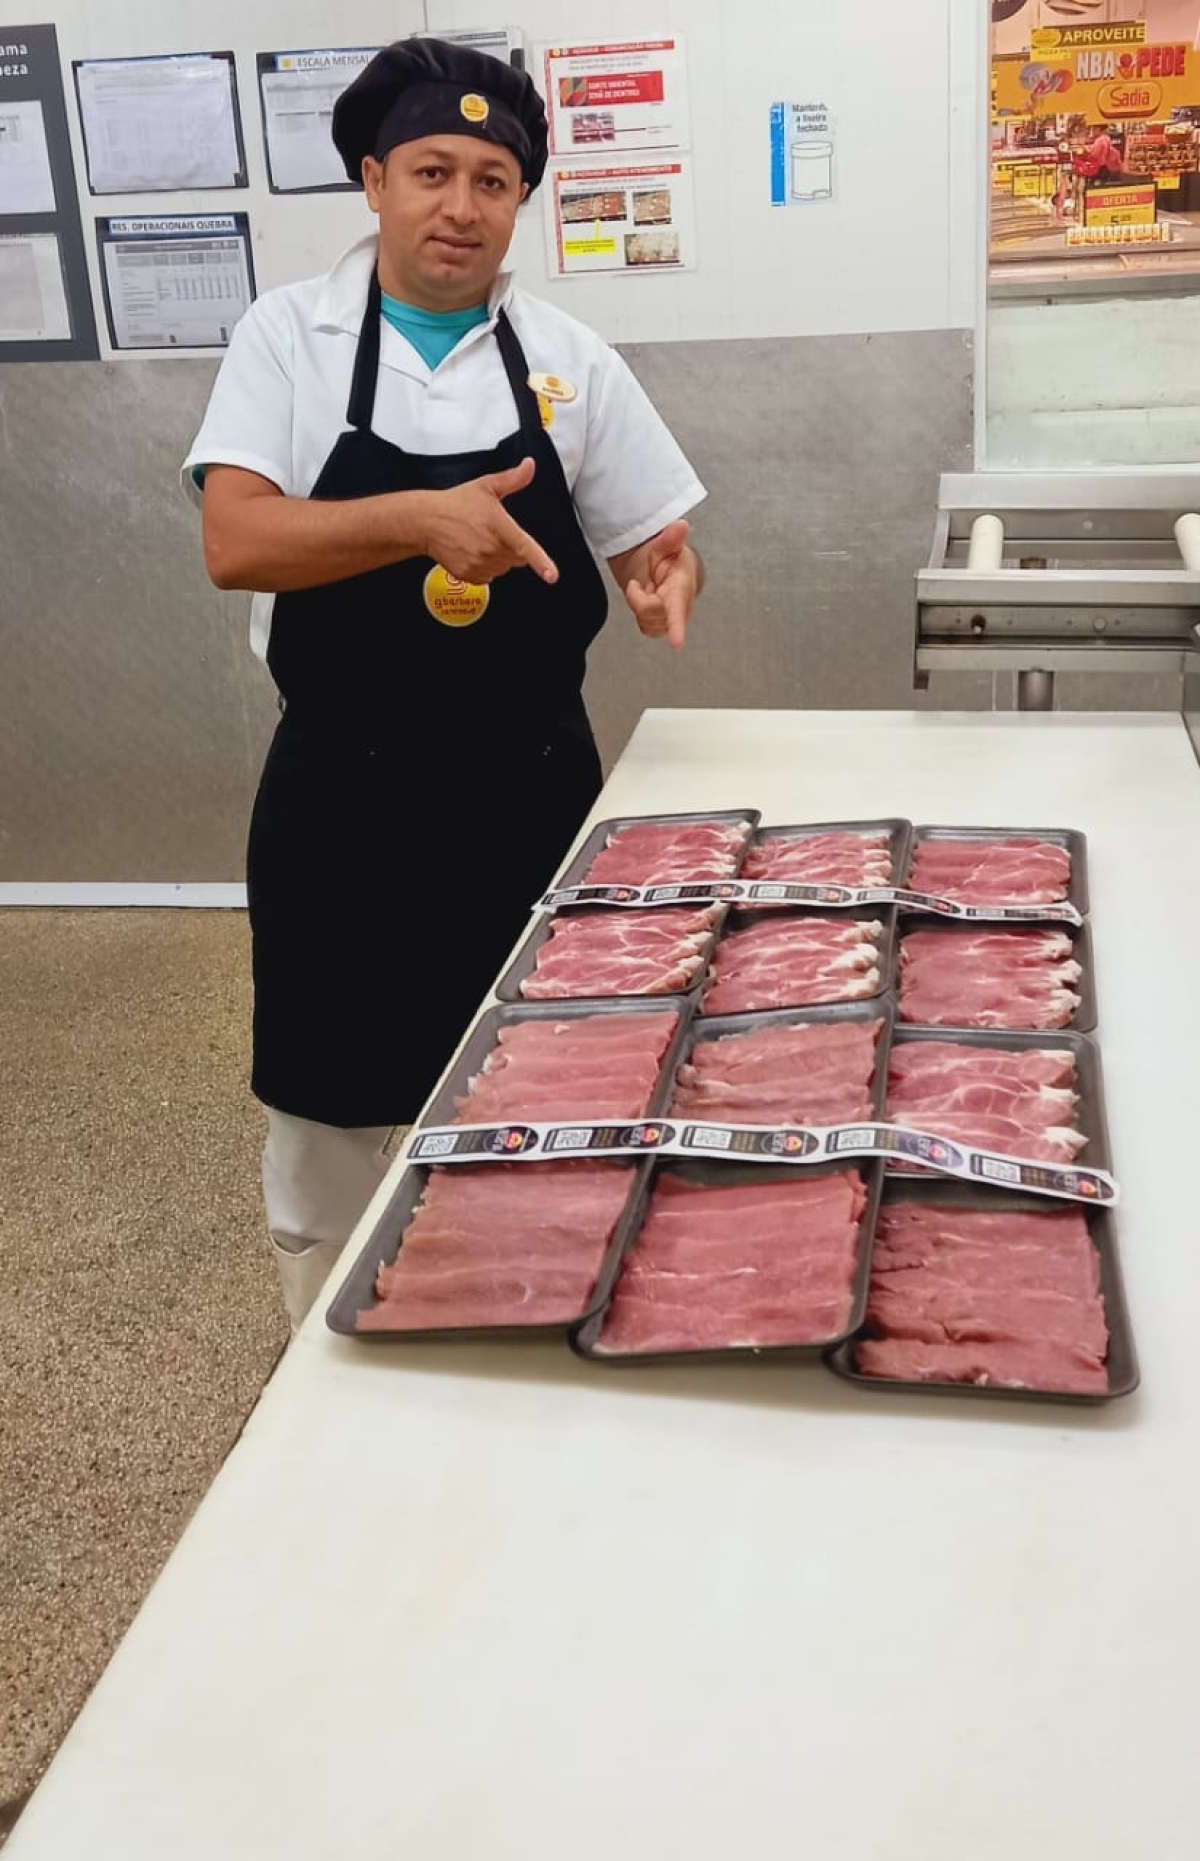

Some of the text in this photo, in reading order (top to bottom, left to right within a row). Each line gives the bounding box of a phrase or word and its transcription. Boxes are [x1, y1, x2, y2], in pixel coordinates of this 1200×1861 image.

[1063, 27, 1145, 43] APROVEITE
[298, 56, 330, 68] ESCALA
[1076, 50, 1116, 81] NBA
[1137, 46, 1186, 78] PEDE
[1110, 86, 1150, 107] Sadia
[131, 220, 195, 232] OPERACIONAIS
[196, 219, 233, 230] QUEBRA
